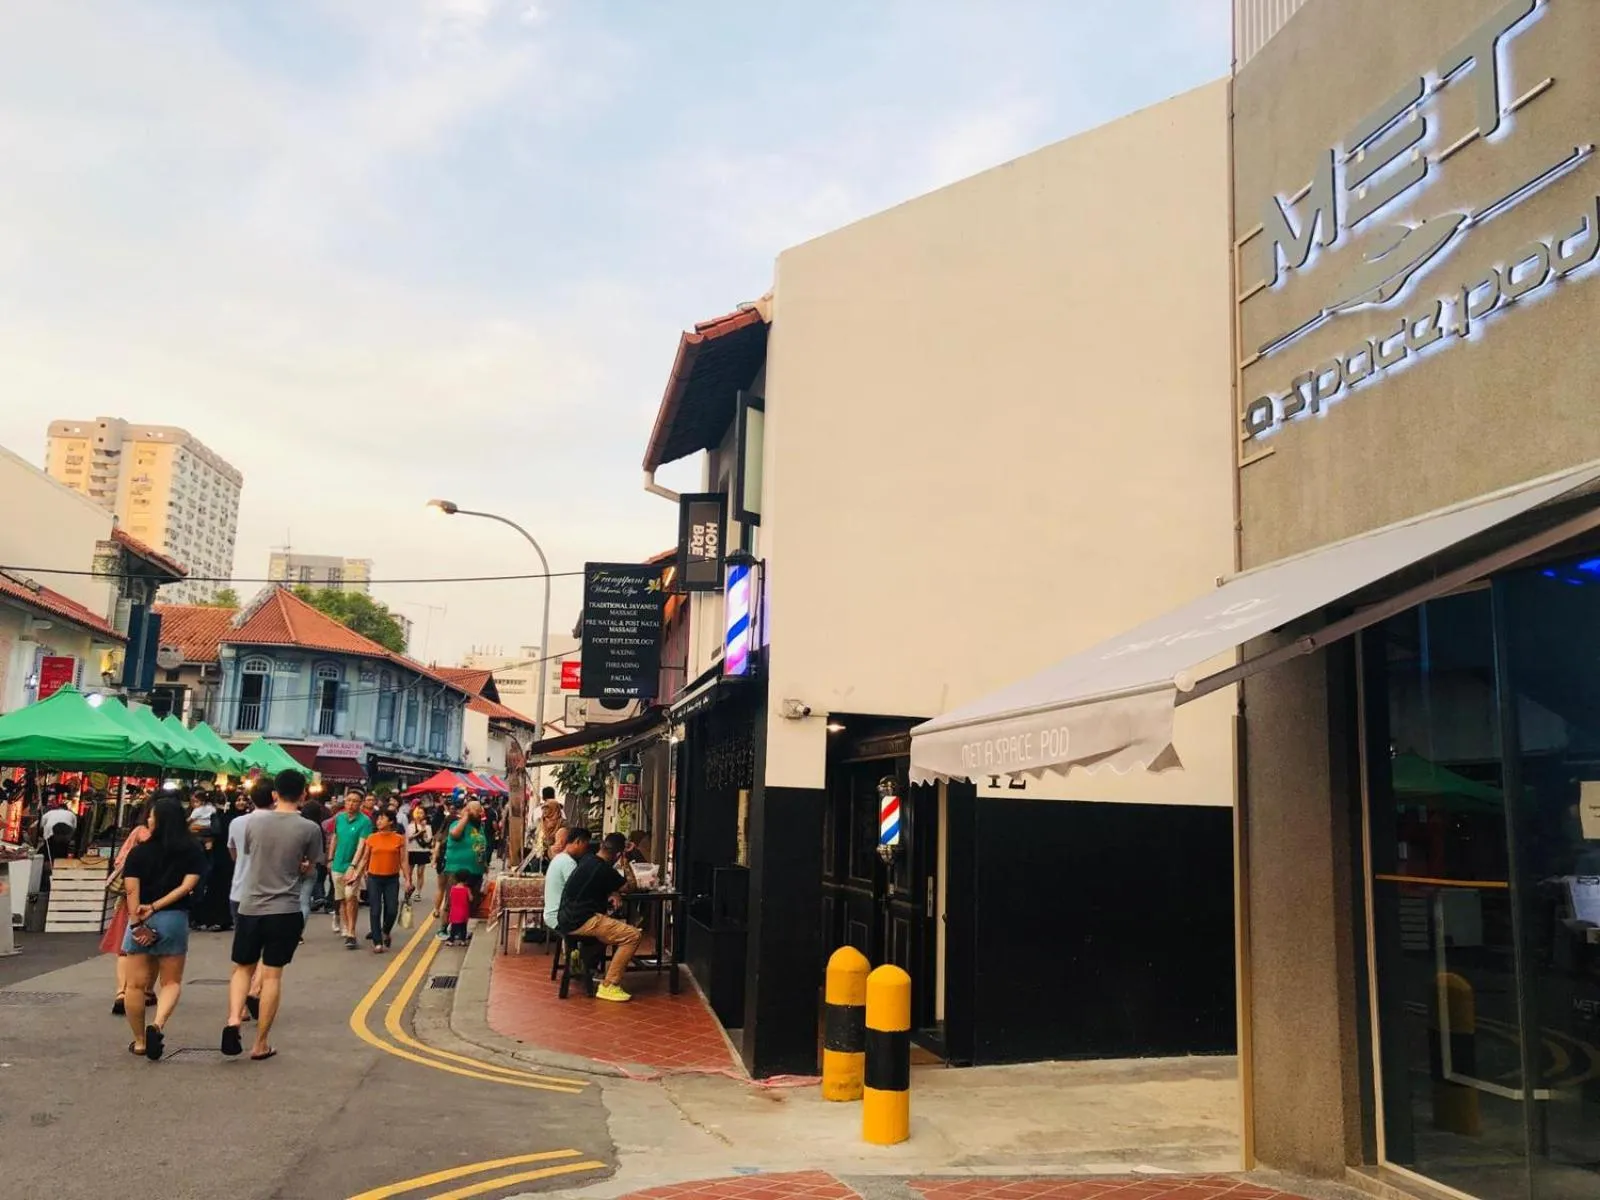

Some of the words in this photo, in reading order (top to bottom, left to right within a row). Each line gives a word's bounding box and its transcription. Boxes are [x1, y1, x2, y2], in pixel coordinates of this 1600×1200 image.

[589, 602, 628, 610] TRADITIONAL
[629, 603, 659, 611] JAVANESE
[609, 638, 655, 646] REFLEXOLOGY
[605, 661, 640, 669] THREADING
[603, 687, 625, 695] HENNA
[1040, 726, 1070, 760] POD
